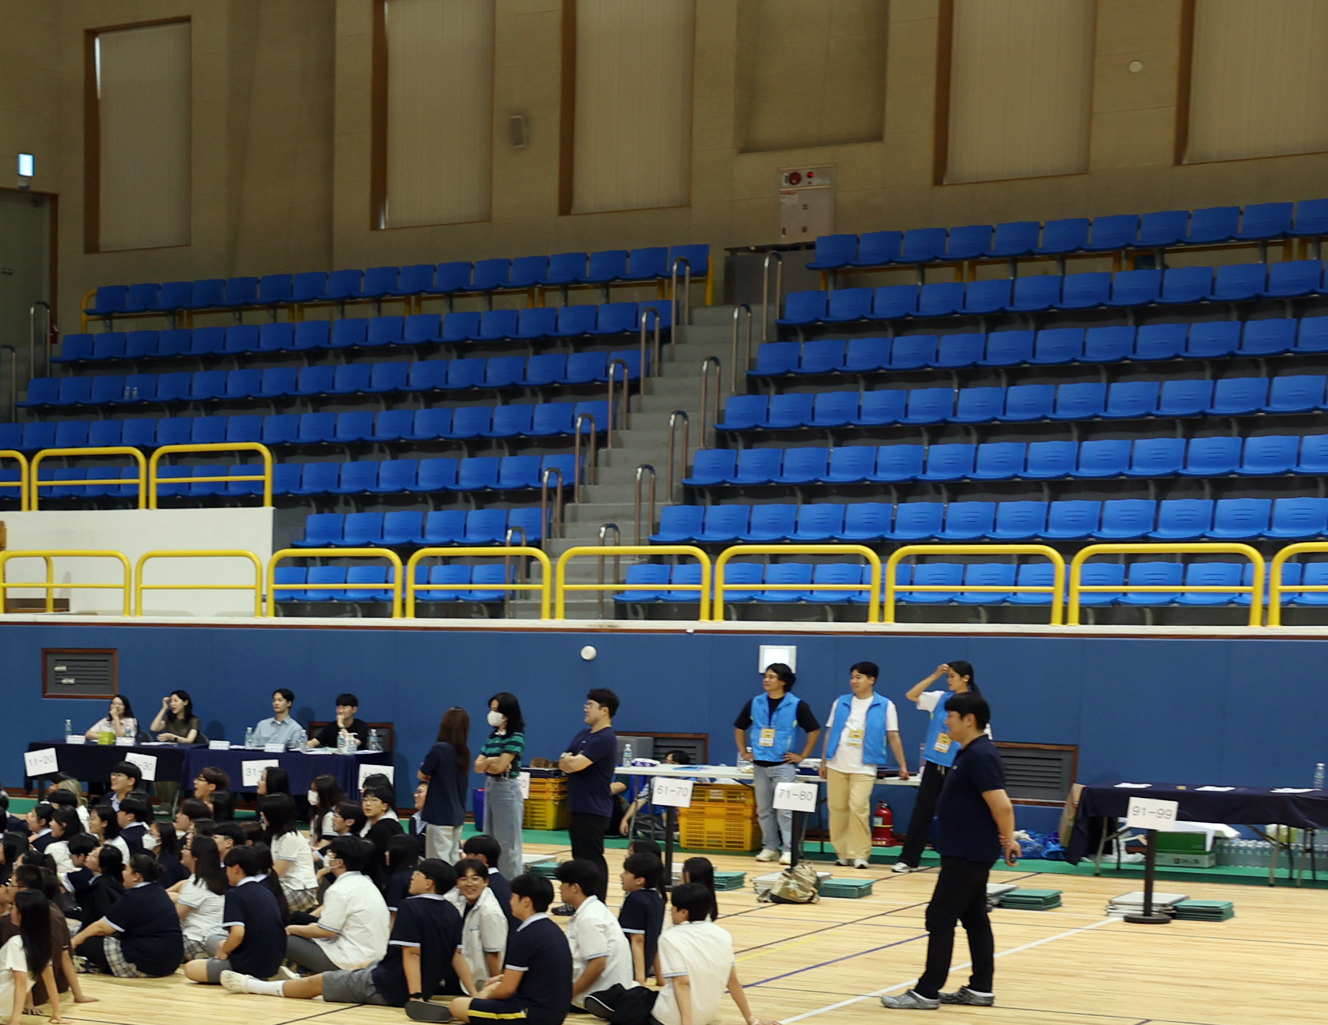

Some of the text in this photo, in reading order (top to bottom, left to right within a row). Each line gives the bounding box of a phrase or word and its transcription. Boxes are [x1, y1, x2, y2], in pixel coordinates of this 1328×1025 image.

[28, 754, 55, 767] 11-20
[656, 784, 689, 798] 61-70
[779, 788, 813, 802] 71-80
[1131, 804, 1173, 820] 91-99
